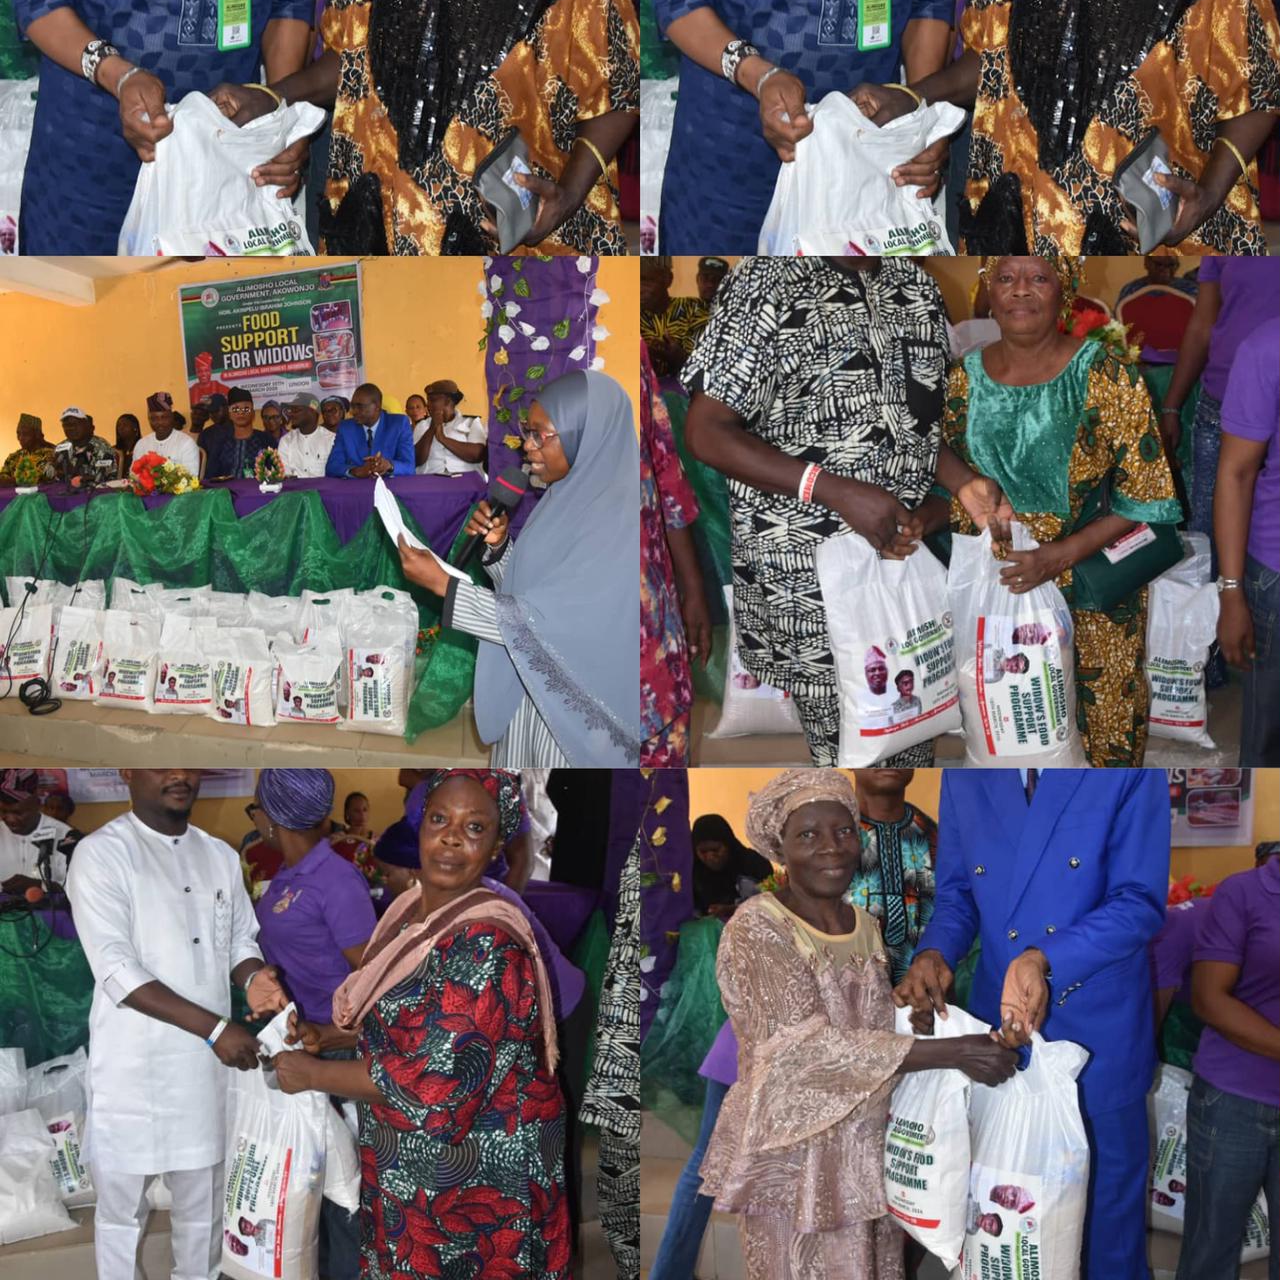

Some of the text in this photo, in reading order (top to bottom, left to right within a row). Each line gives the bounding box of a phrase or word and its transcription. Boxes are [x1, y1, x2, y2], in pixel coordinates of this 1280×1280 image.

[243, 237, 266, 249] LOCAL
[883, 237, 906, 249] LOCAL
[236, 279, 298, 293] ALIMOSHO LOCAL
[273, 284, 315, 295] AKOWONJO
[242, 311, 280, 332] FOOD
[221, 326, 299, 353] SUPPORT
[224, 350, 251, 370] FOR
[1048, 663, 1063, 726] LOCAL GOVERNMENT
[1056, 668, 1066, 719] ALIMOSHO
[1153, 693, 1198, 703] PROGRAMME
[1009, 685, 1028, 744] PROGRAMME
[1021, 692, 1037, 735] SUPPORT
[1031, 676, 1050, 746] WIDOW'S FOOD
